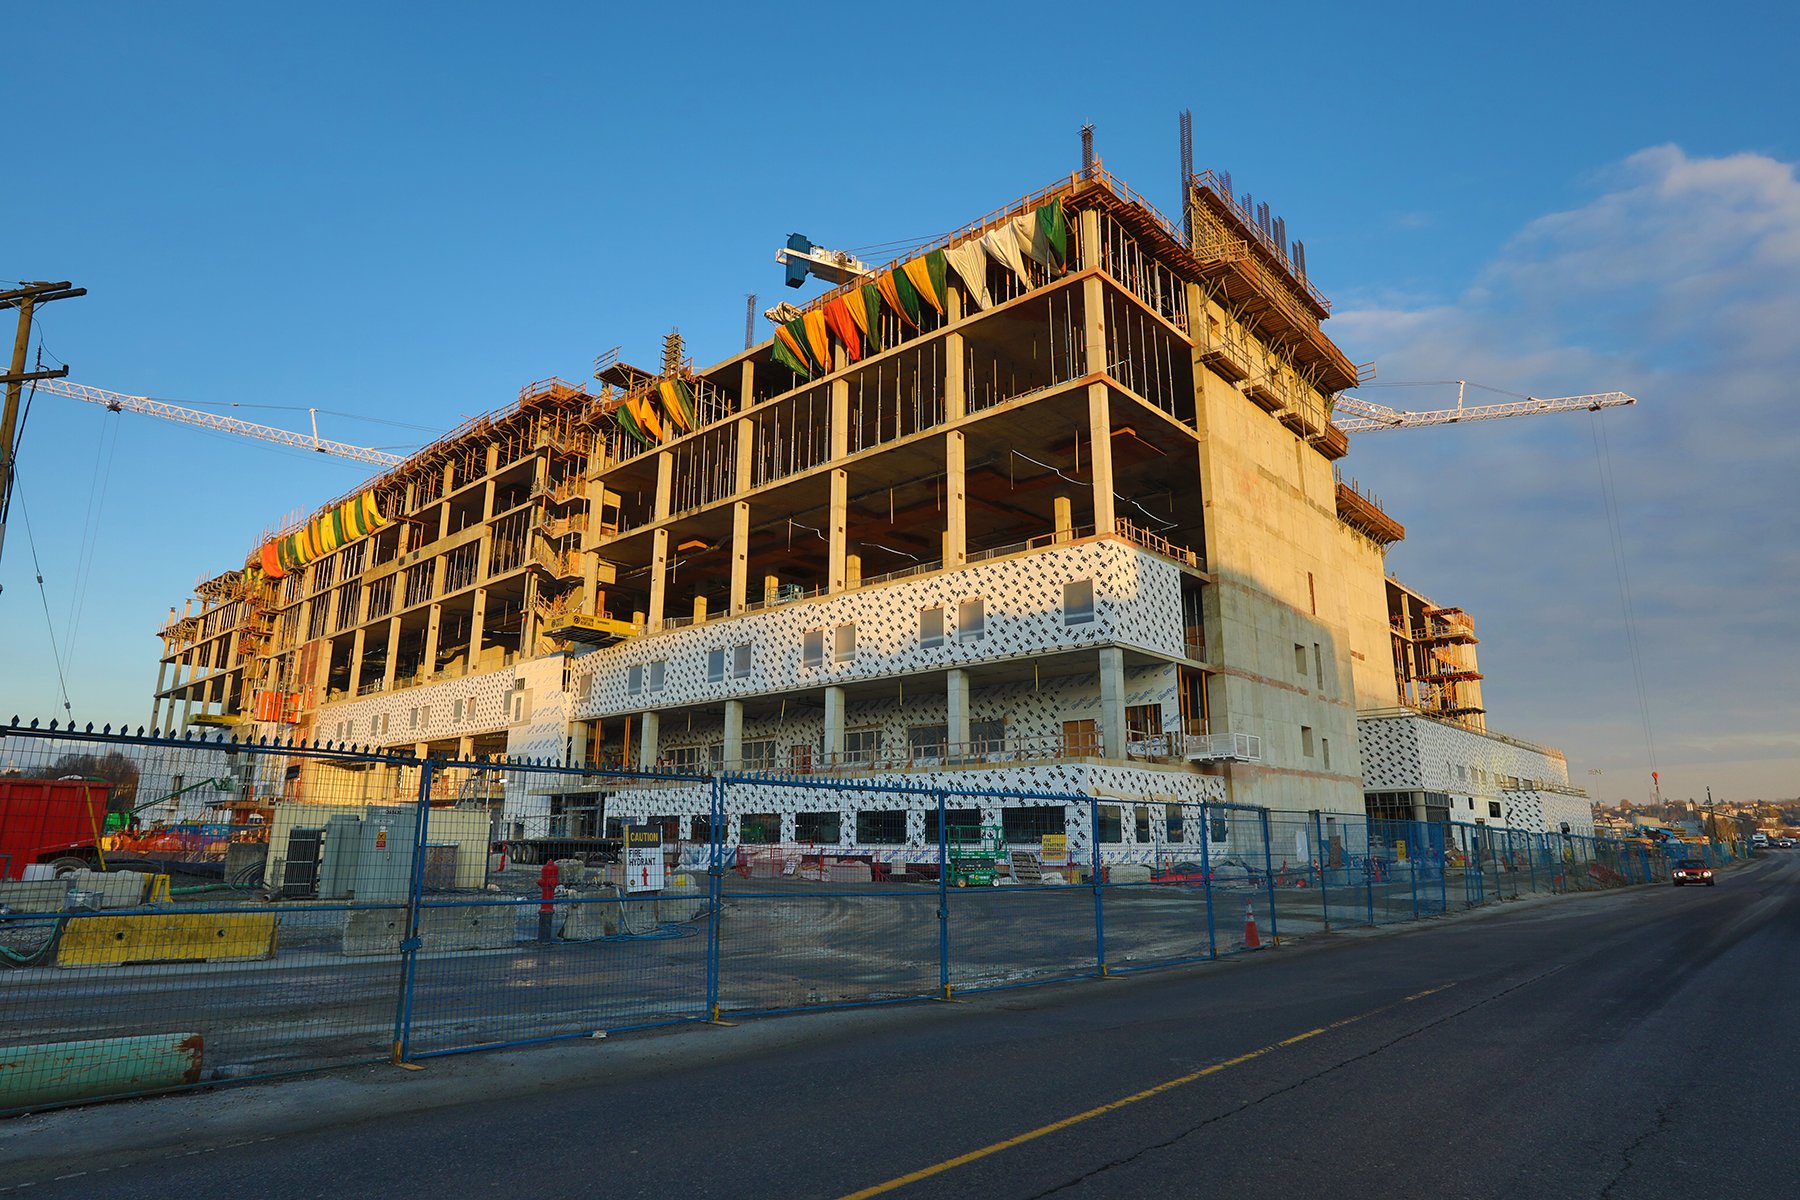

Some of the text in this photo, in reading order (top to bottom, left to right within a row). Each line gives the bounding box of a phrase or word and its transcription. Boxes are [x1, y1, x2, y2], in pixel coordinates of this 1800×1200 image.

[630, 832, 658, 842] CAUTION
[629, 849, 642, 857] FIRE
[629, 857, 656, 866] HYDRANT
